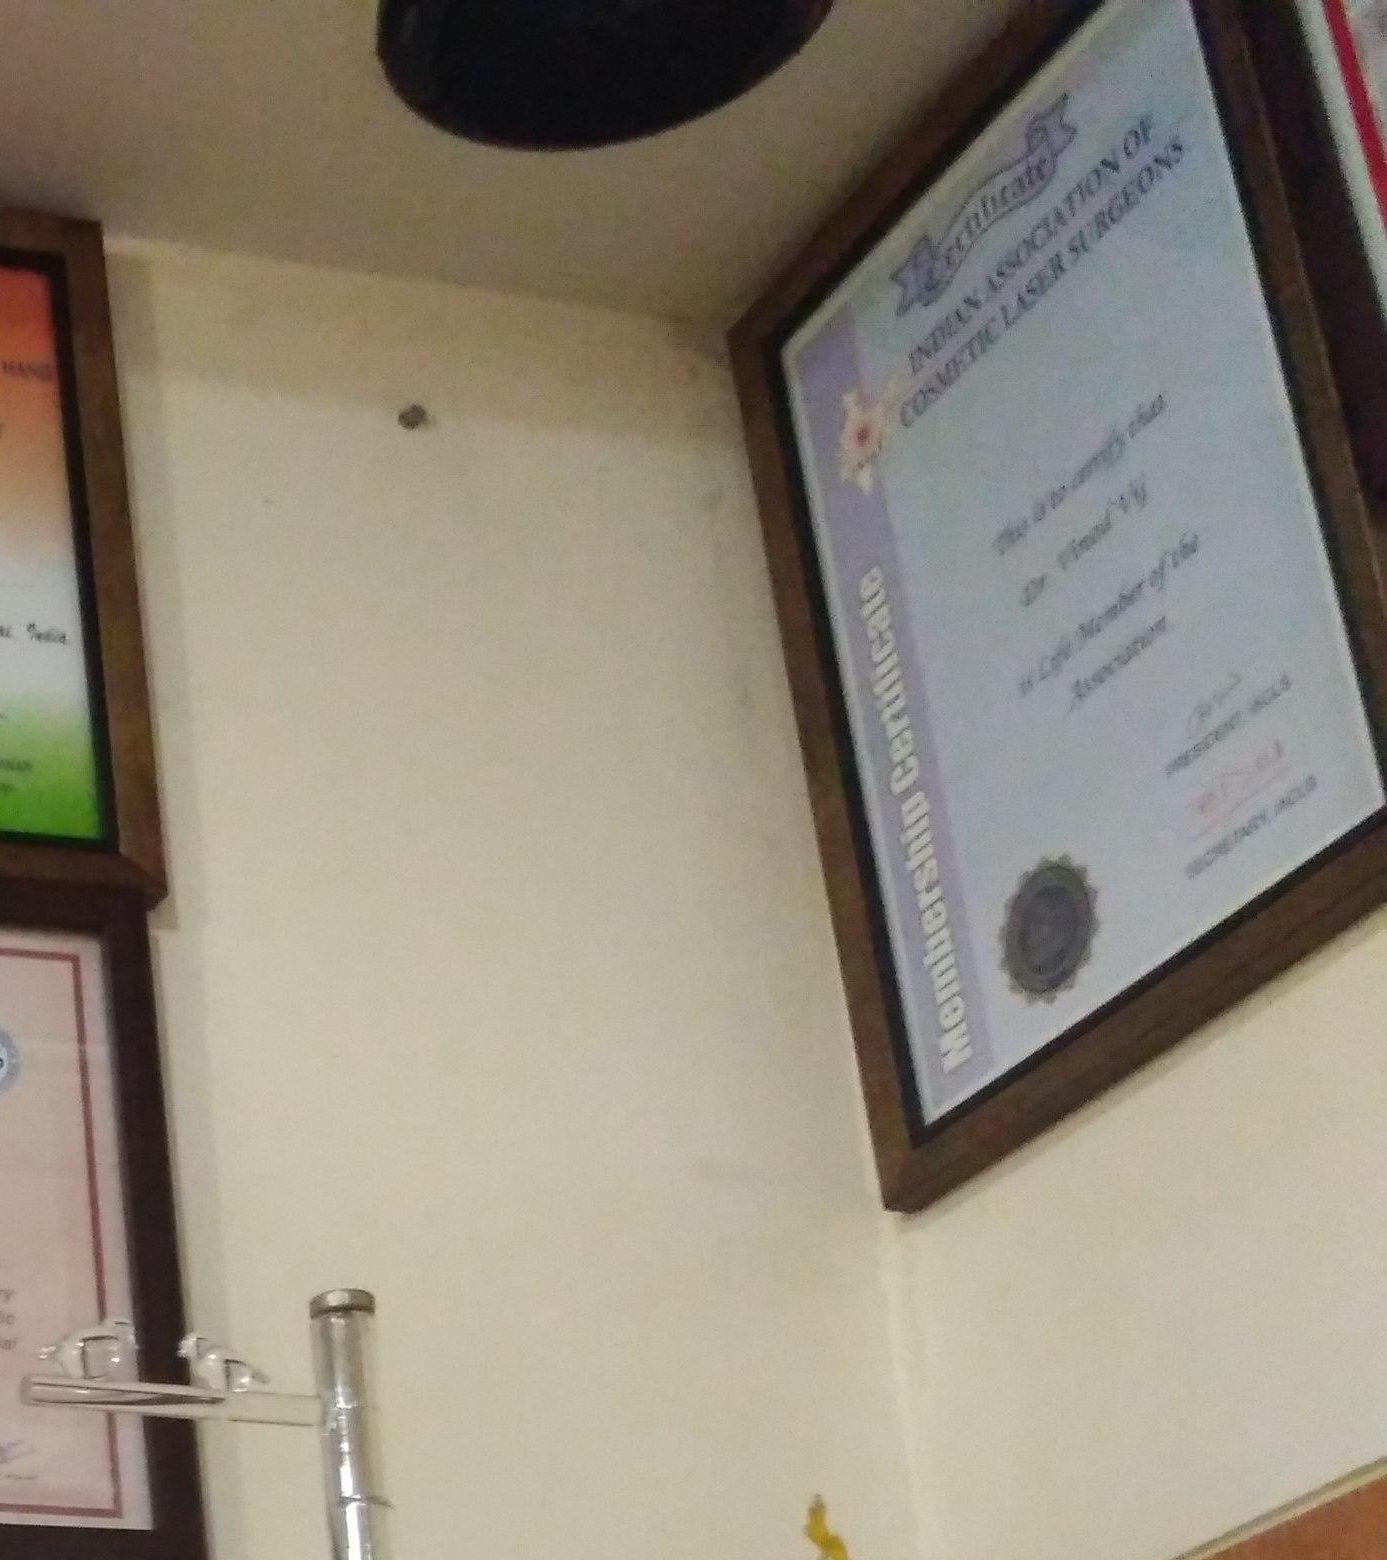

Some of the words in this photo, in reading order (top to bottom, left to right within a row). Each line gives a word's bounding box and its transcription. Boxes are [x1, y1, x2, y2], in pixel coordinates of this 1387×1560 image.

[899, 317, 1003, 429] COSMETIC
[1001, 252, 1067, 332] LASER
[1068, 138, 1184, 257] SURGEONS
[909, 290, 982, 376] INDIAN
[986, 154, 1121, 292] ASSOCIATION
[914, 153, 1059, 307] Certificate
[859, 563, 920, 797] Certificate
[900, 788, 975, 1075] Membership
